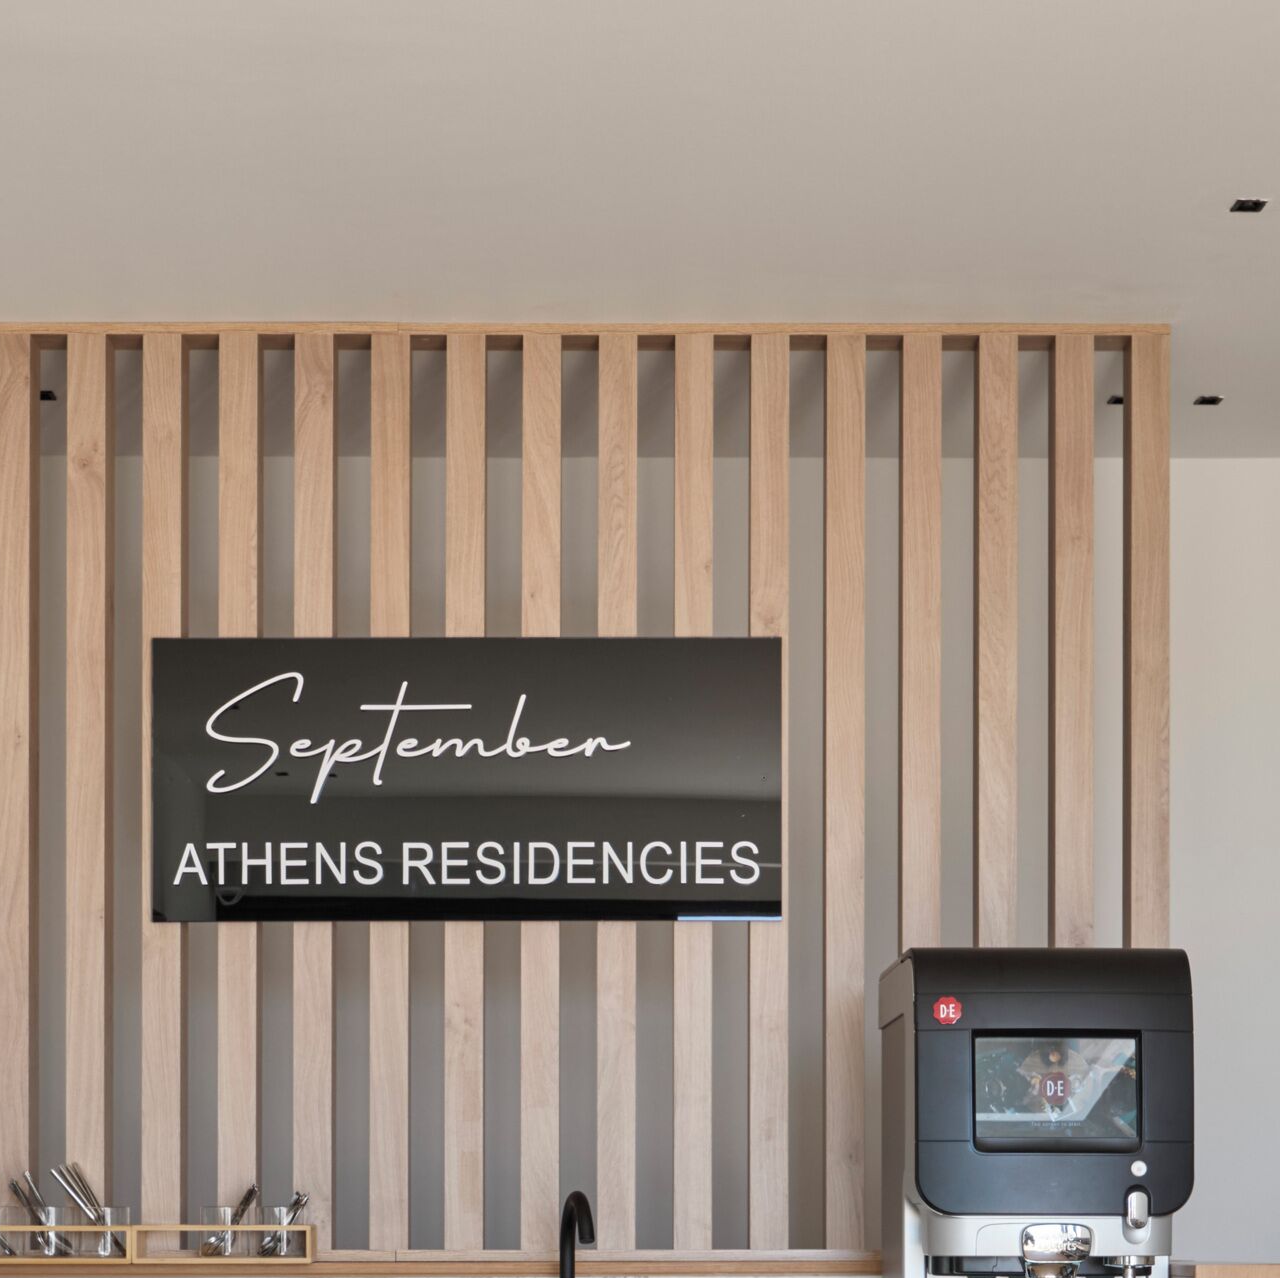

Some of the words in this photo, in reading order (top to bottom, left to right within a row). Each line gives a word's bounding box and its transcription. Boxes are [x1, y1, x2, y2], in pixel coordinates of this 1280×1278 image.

[205, 671, 631, 804] September
[173, 840, 384, 886] ATHENS
[402, 840, 761, 886] RESIDENCIES
